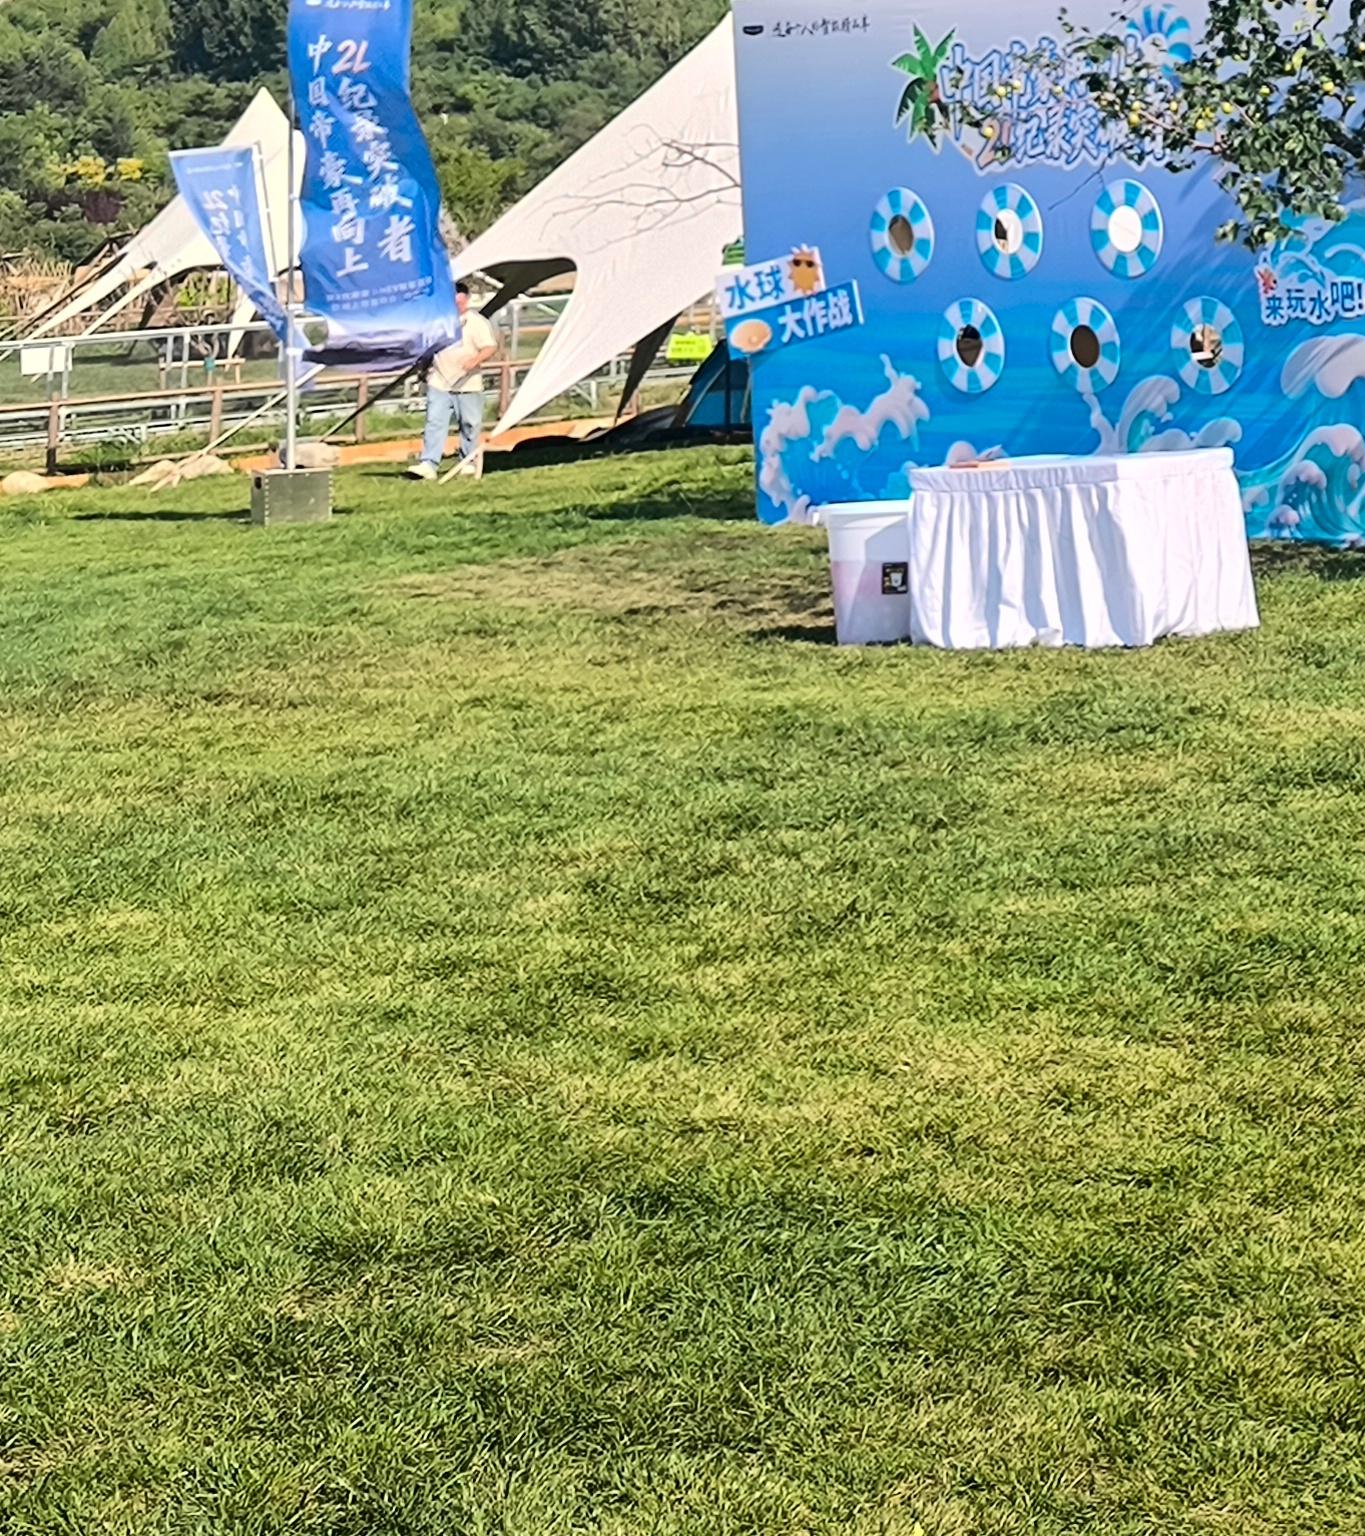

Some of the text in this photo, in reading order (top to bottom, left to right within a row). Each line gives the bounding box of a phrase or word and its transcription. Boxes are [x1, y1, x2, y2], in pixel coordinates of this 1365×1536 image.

[307, 33, 368, 277] 中国帝豪再向上
[725, 264, 785, 310] 水球
[1265, 281, 1363, 321] 来玩水吧!
[778, 289, 853, 344] 大作战
